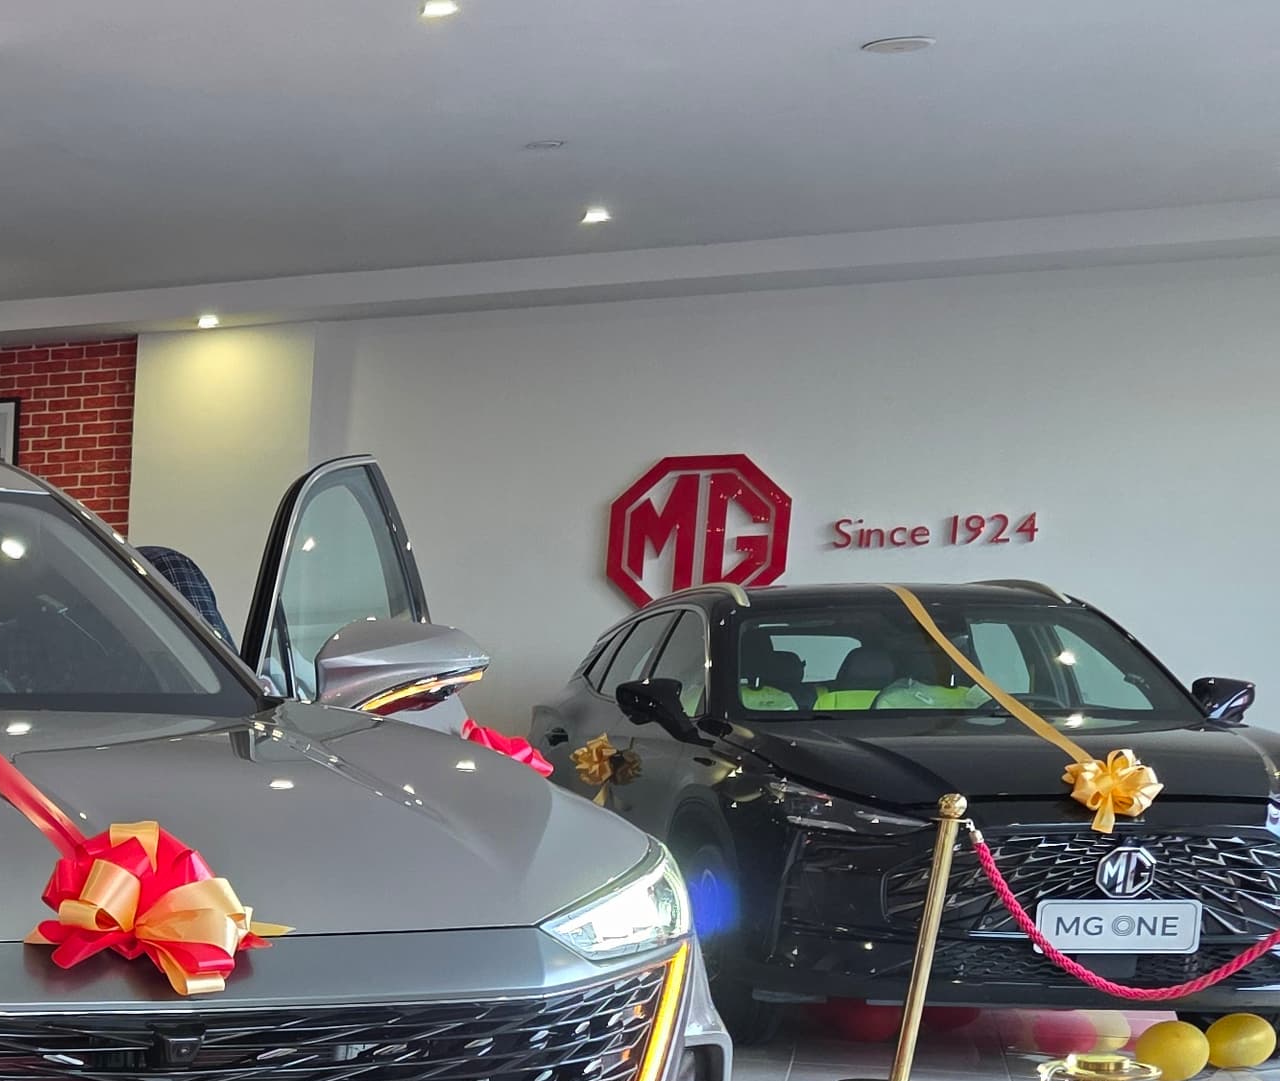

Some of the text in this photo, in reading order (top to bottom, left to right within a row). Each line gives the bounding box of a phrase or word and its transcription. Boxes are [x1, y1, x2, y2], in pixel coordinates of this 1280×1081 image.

[624, 472, 770, 585] MG
[833, 511, 1039, 549] Since 1924
[1104, 852, 1150, 894] MG
[1055, 915, 1180, 937] MG ONE
